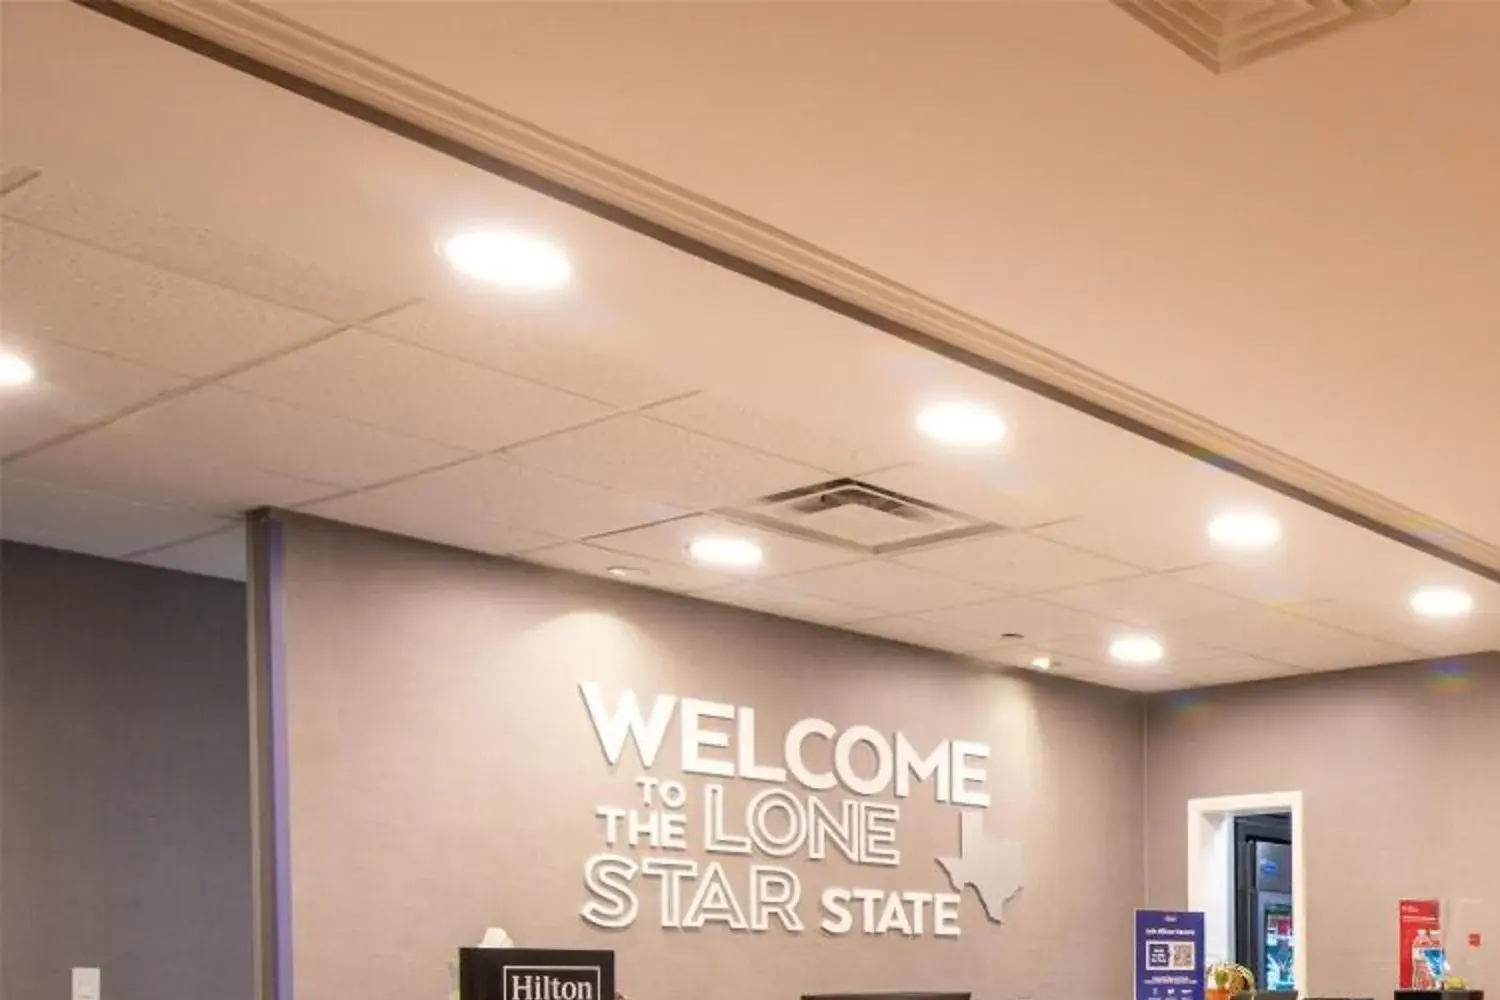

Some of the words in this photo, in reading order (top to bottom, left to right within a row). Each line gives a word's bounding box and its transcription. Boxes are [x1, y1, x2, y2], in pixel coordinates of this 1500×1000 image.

[578, 681, 992, 809] WELCOME
[596, 805, 688, 850] THE
[704, 784, 900, 866] LONE
[636, 776, 687, 808] TO
[579, 853, 804, 932] STAR
[821, 887, 962, 936] STATE
[511, 975, 593, 1000] Hilton
